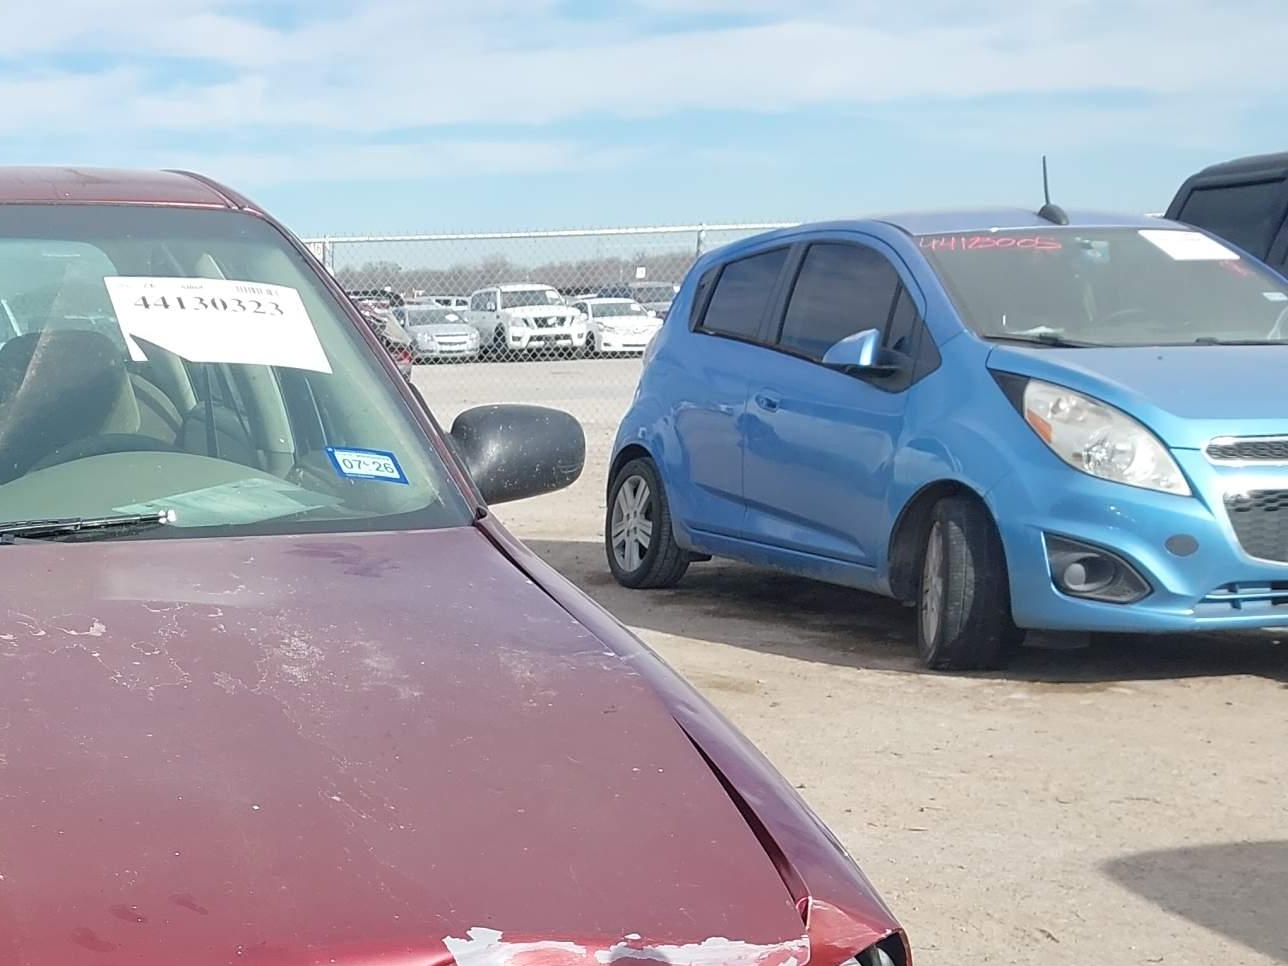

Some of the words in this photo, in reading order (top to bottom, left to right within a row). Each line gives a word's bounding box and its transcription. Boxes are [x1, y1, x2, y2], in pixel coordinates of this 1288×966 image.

[133, 295, 285, 317] 44130323
[342, 458, 362, 471] 07
[372, 461, 395, 474] 26
